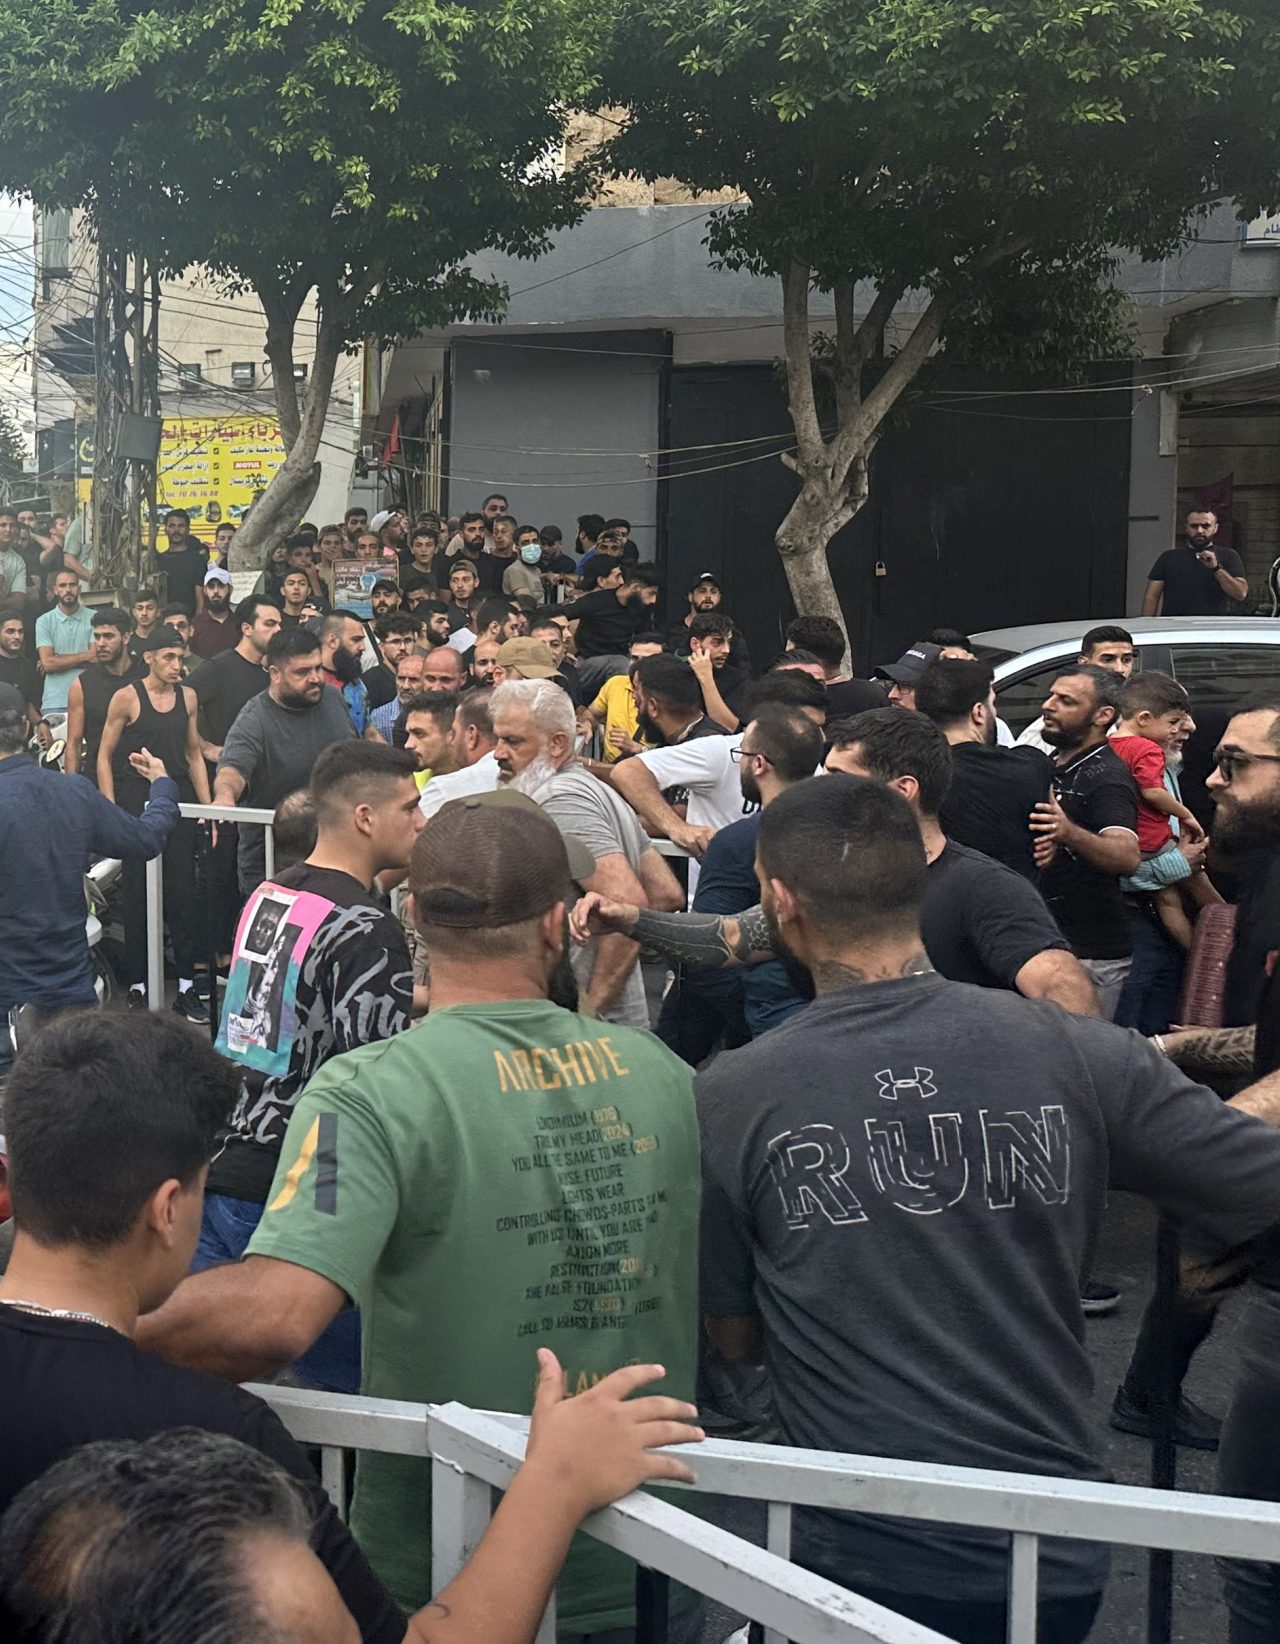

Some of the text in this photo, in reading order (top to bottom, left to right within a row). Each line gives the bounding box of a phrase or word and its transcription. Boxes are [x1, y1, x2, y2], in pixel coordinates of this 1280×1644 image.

[494, 1037, 629, 1092] ARCHIVE
[511, 1157, 532, 1172] YOU
[532, 1153, 551, 1168] ALL
[564, 1150, 597, 1167] SAME
[598, 1146, 611, 1161] TO
[612, 1142, 629, 1158] ME
[768, 1105, 1069, 1230] RUN
[585, 1163, 624, 1183] FUTURE
[596, 1182, 625, 1201] WEAR
[622, 1217, 643, 1234] ARE
